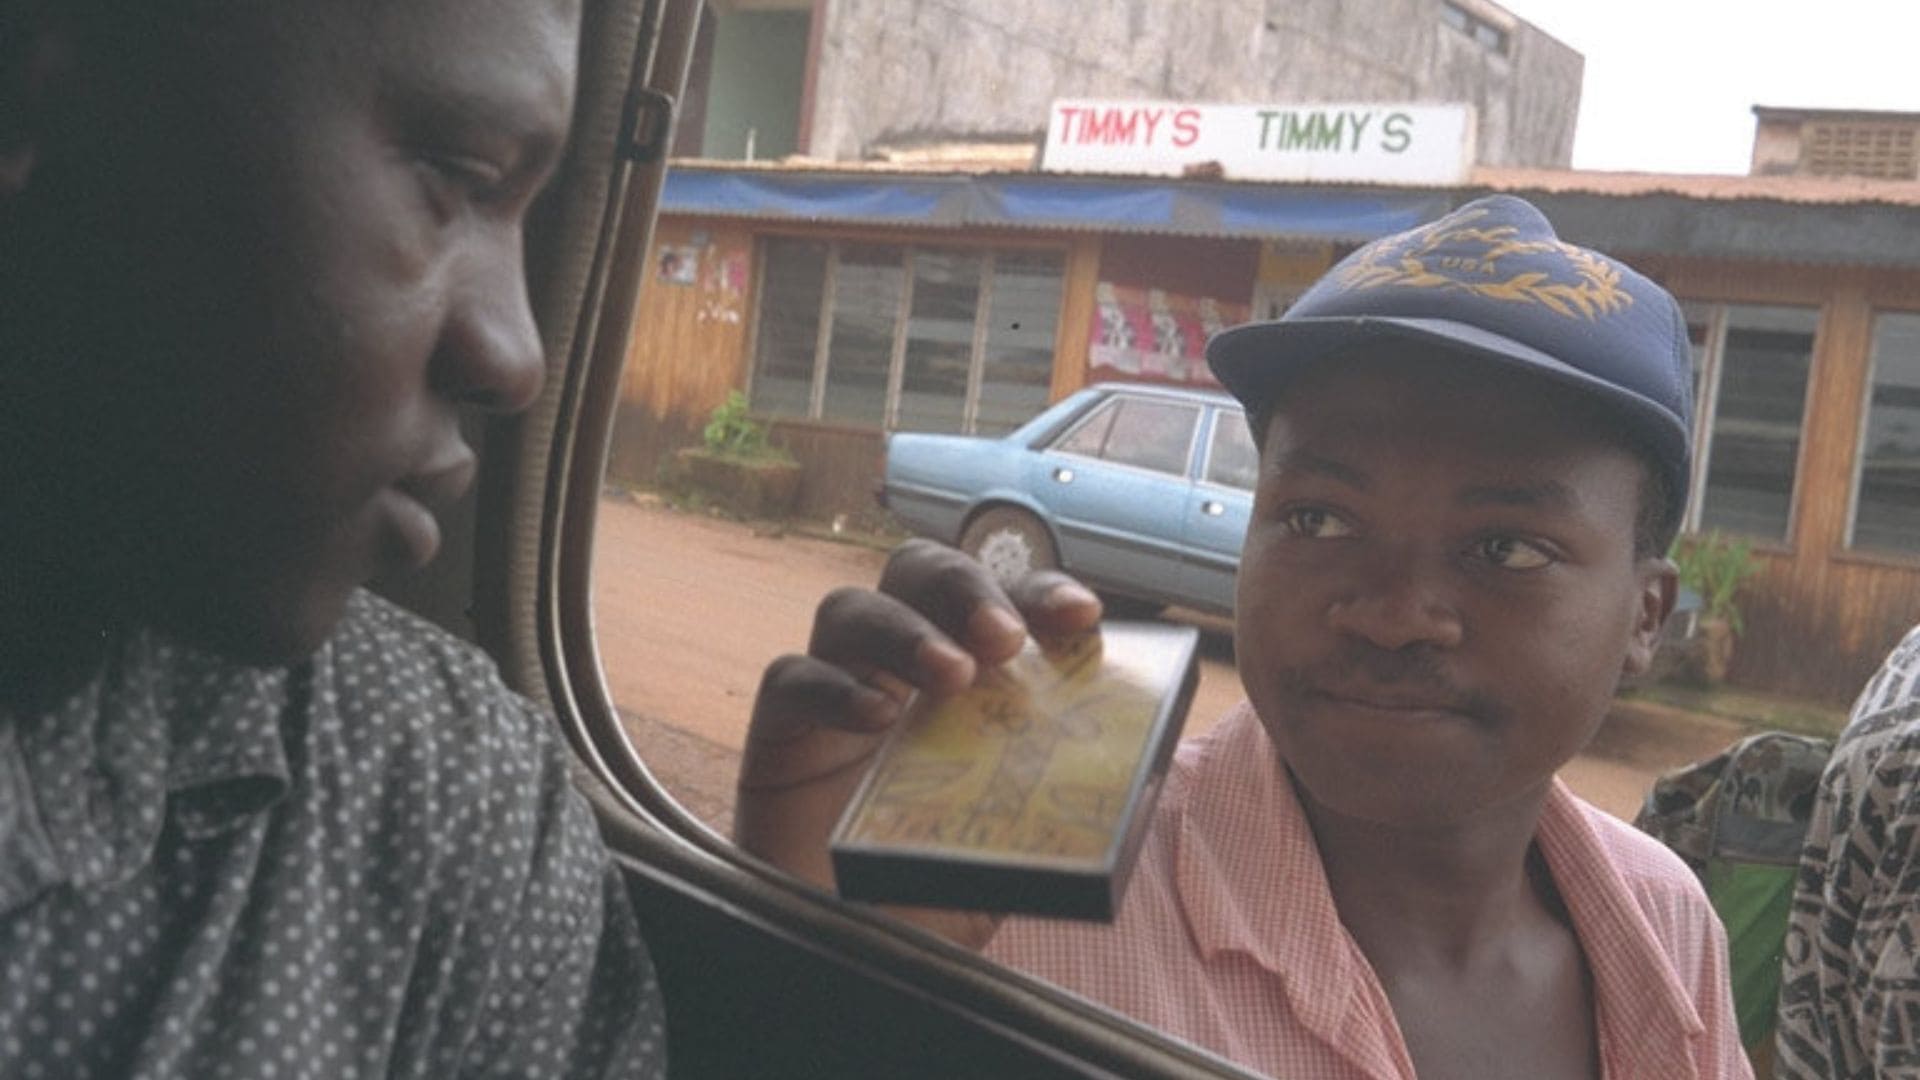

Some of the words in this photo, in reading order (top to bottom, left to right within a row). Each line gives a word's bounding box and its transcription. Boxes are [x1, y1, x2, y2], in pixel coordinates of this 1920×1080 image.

[1059, 107, 1203, 148] TIMMY'S
[1255, 109, 1414, 153] TIMMY'S
[1440, 255, 1497, 276] USA
